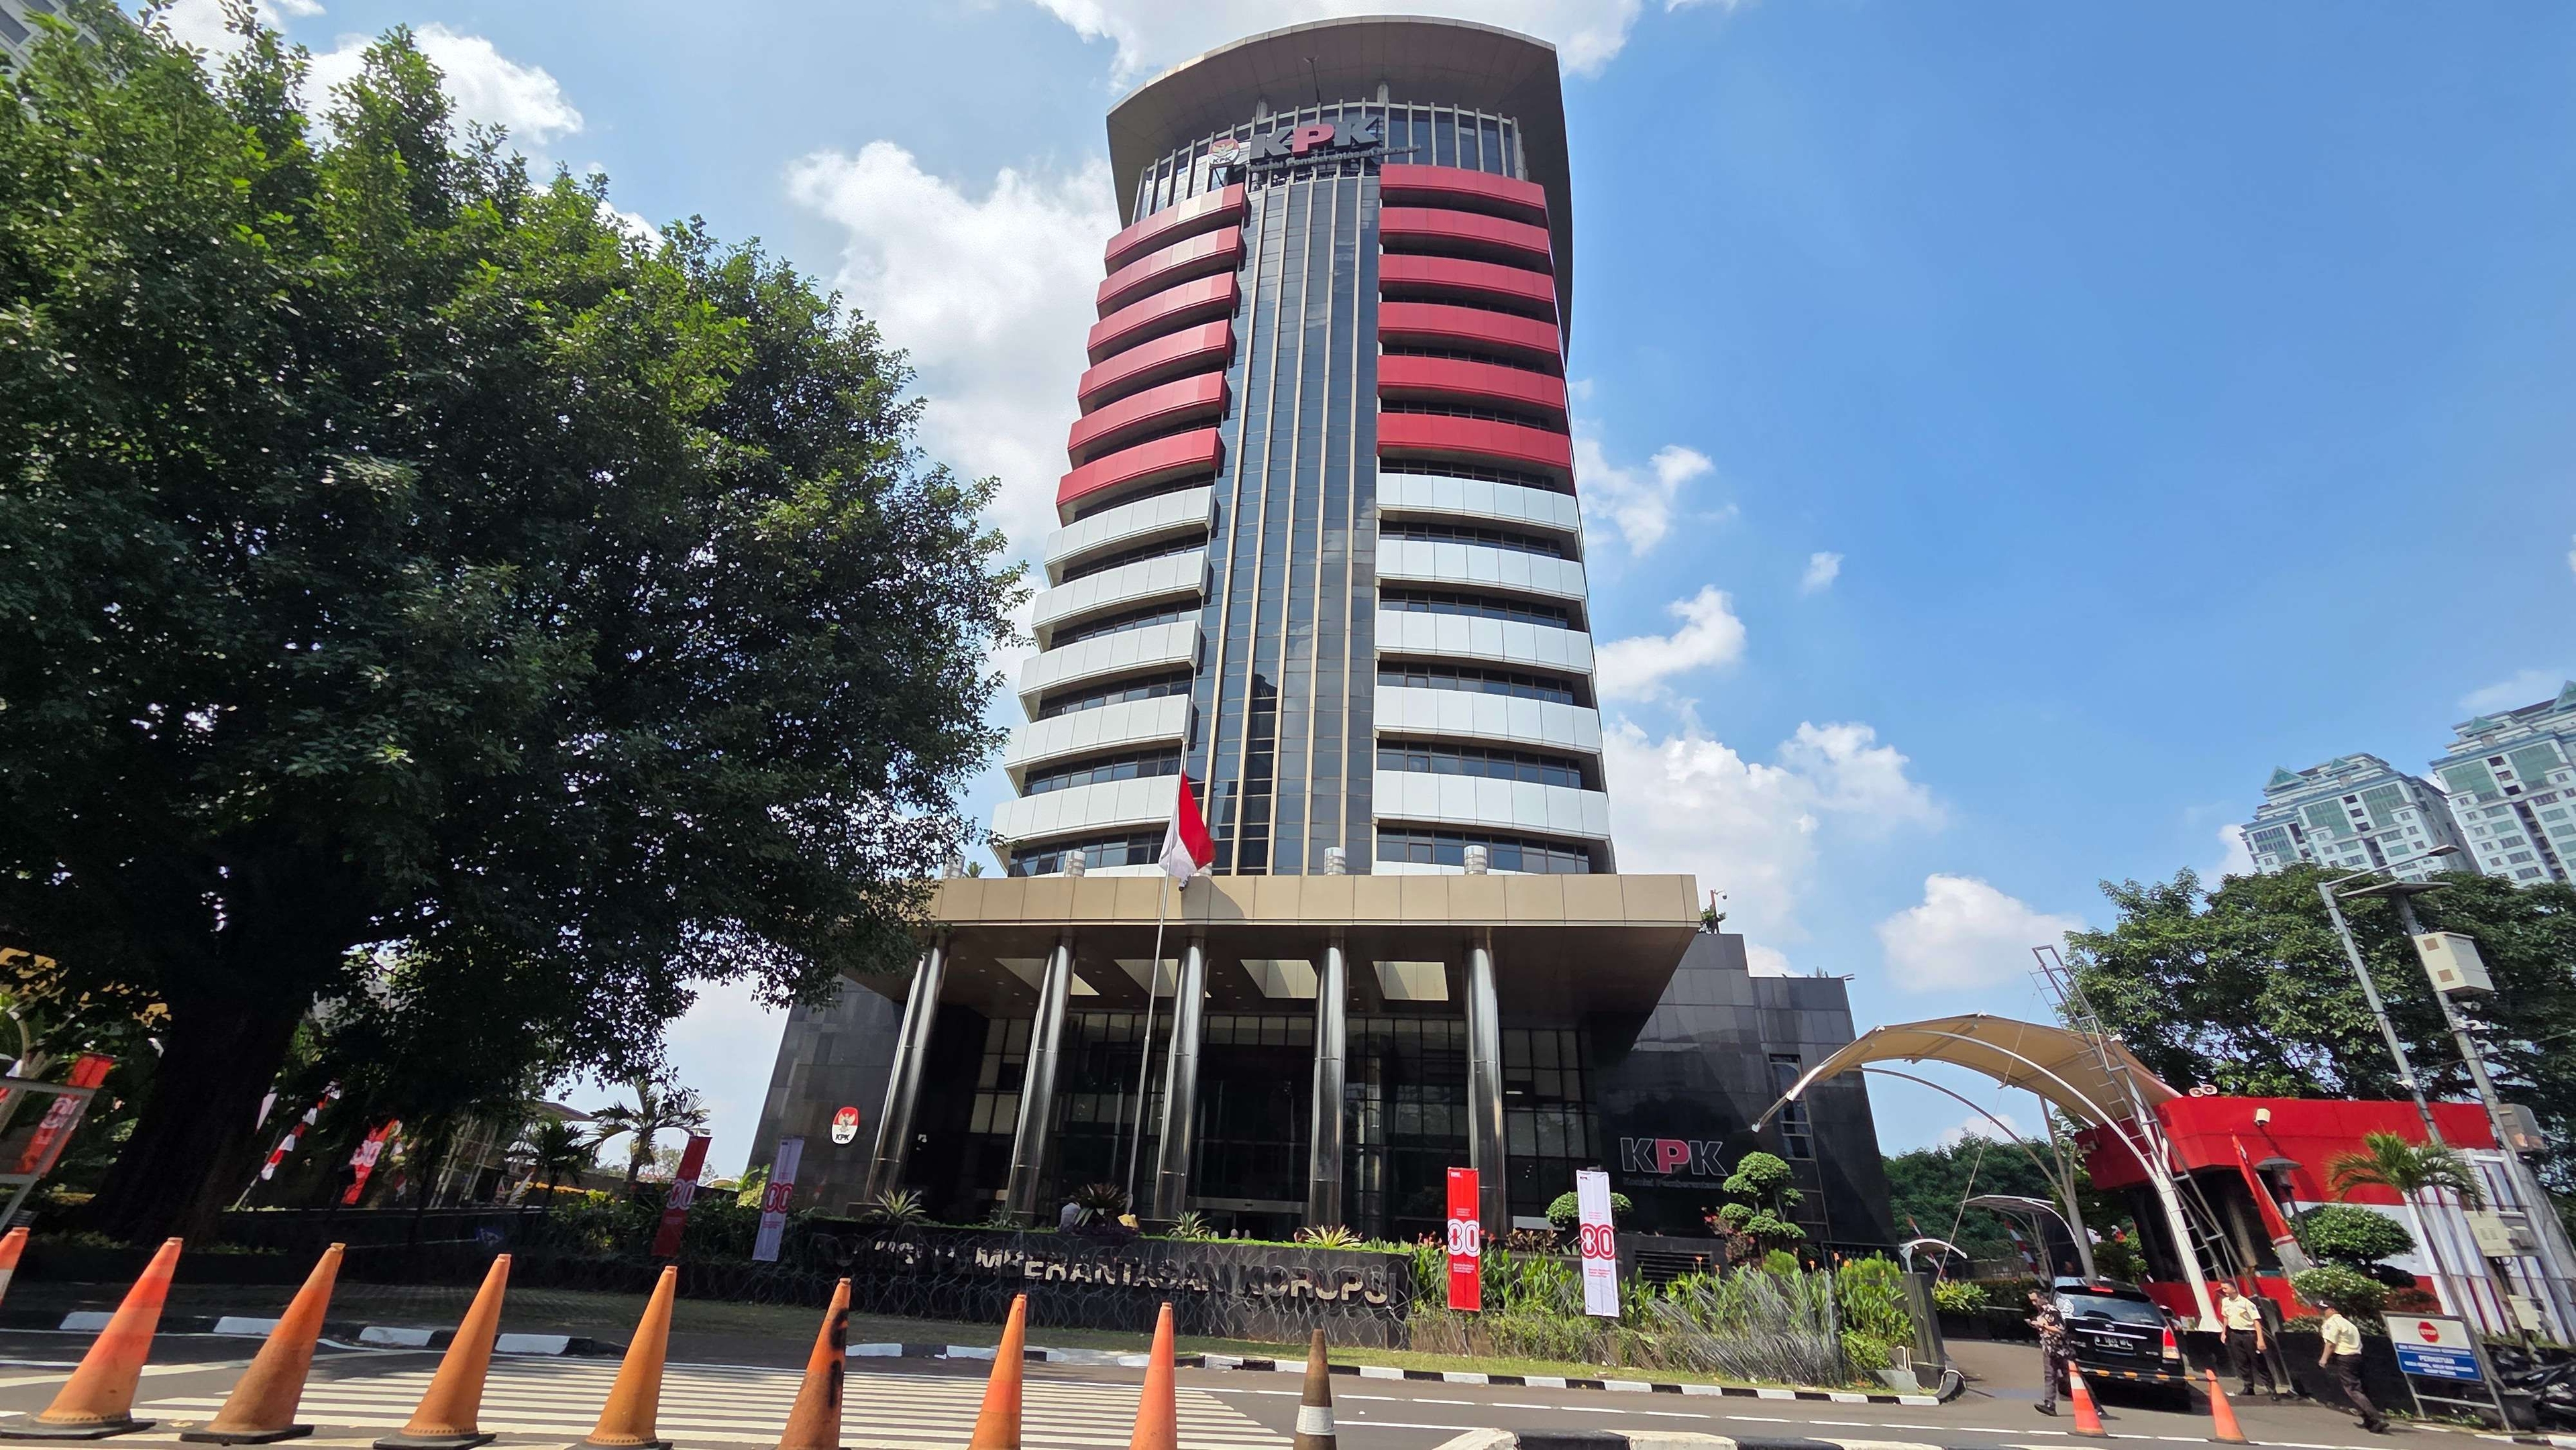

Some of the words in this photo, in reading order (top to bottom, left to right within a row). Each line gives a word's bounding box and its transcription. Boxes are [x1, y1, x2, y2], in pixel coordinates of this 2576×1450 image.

[1249, 117, 1381, 159] KPK
[1212, 156, 1232, 164] KPK
[1620, 1137, 1729, 1177] KPK
[666, 1179, 696, 1211] 80
[765, 1182, 794, 1213] 80
[1448, 1219, 1481, 1257] 80
[1580, 1223, 1616, 1260] 80
